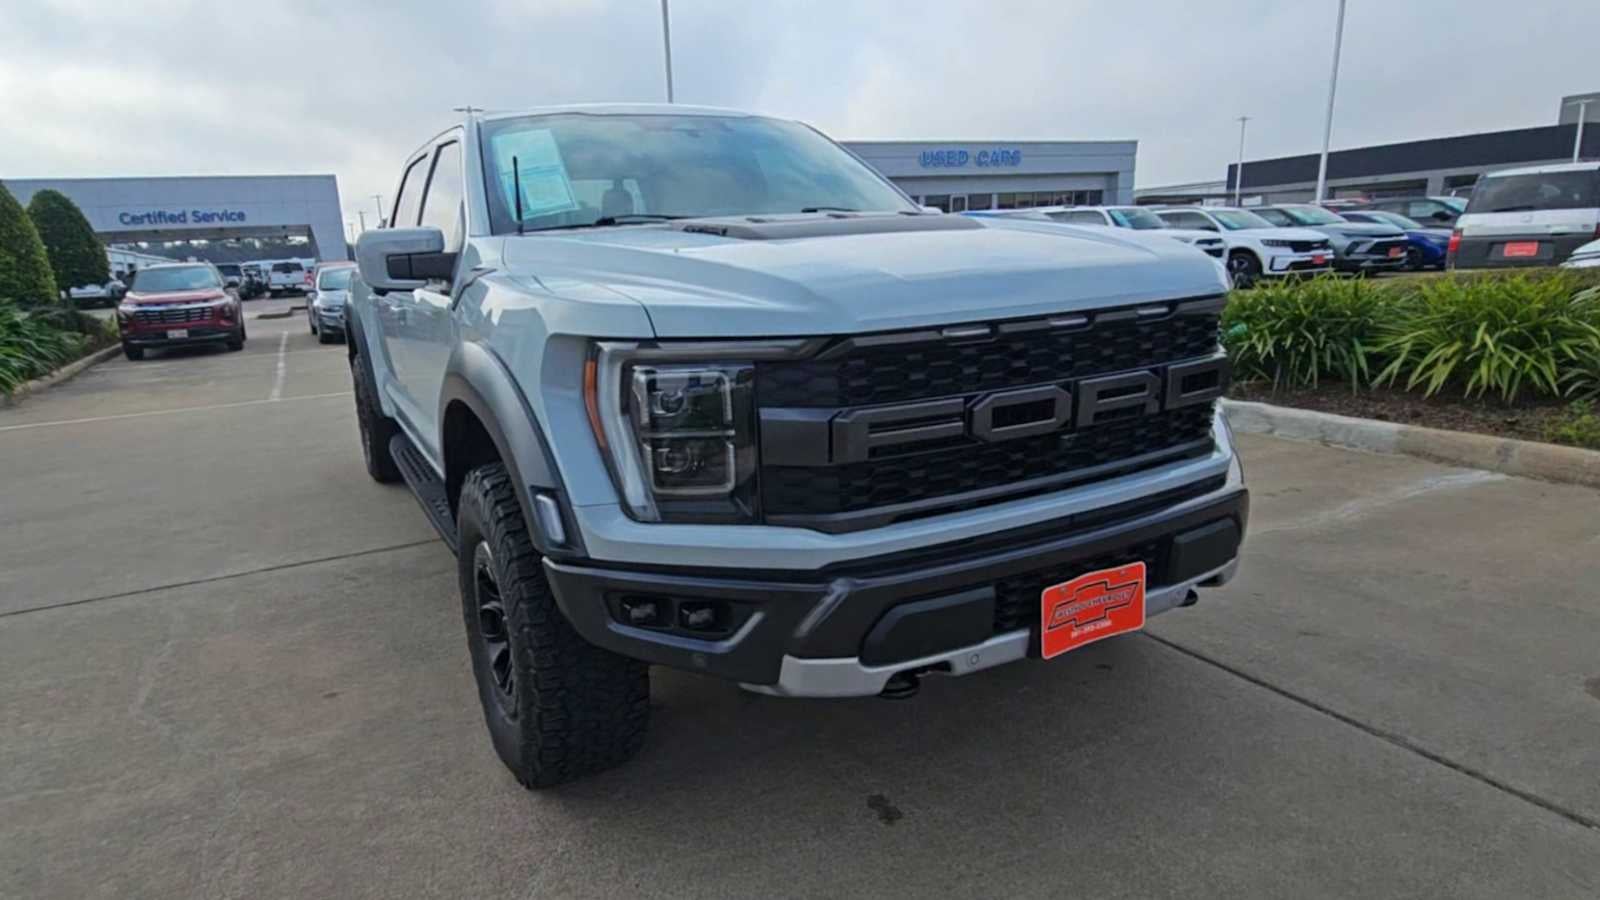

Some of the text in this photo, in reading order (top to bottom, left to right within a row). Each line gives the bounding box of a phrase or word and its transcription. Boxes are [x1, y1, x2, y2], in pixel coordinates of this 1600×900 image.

[919, 149, 1022, 168] USED CARS
[119, 209, 246, 225] Certified Service
[832, 356, 1229, 464] FORD
